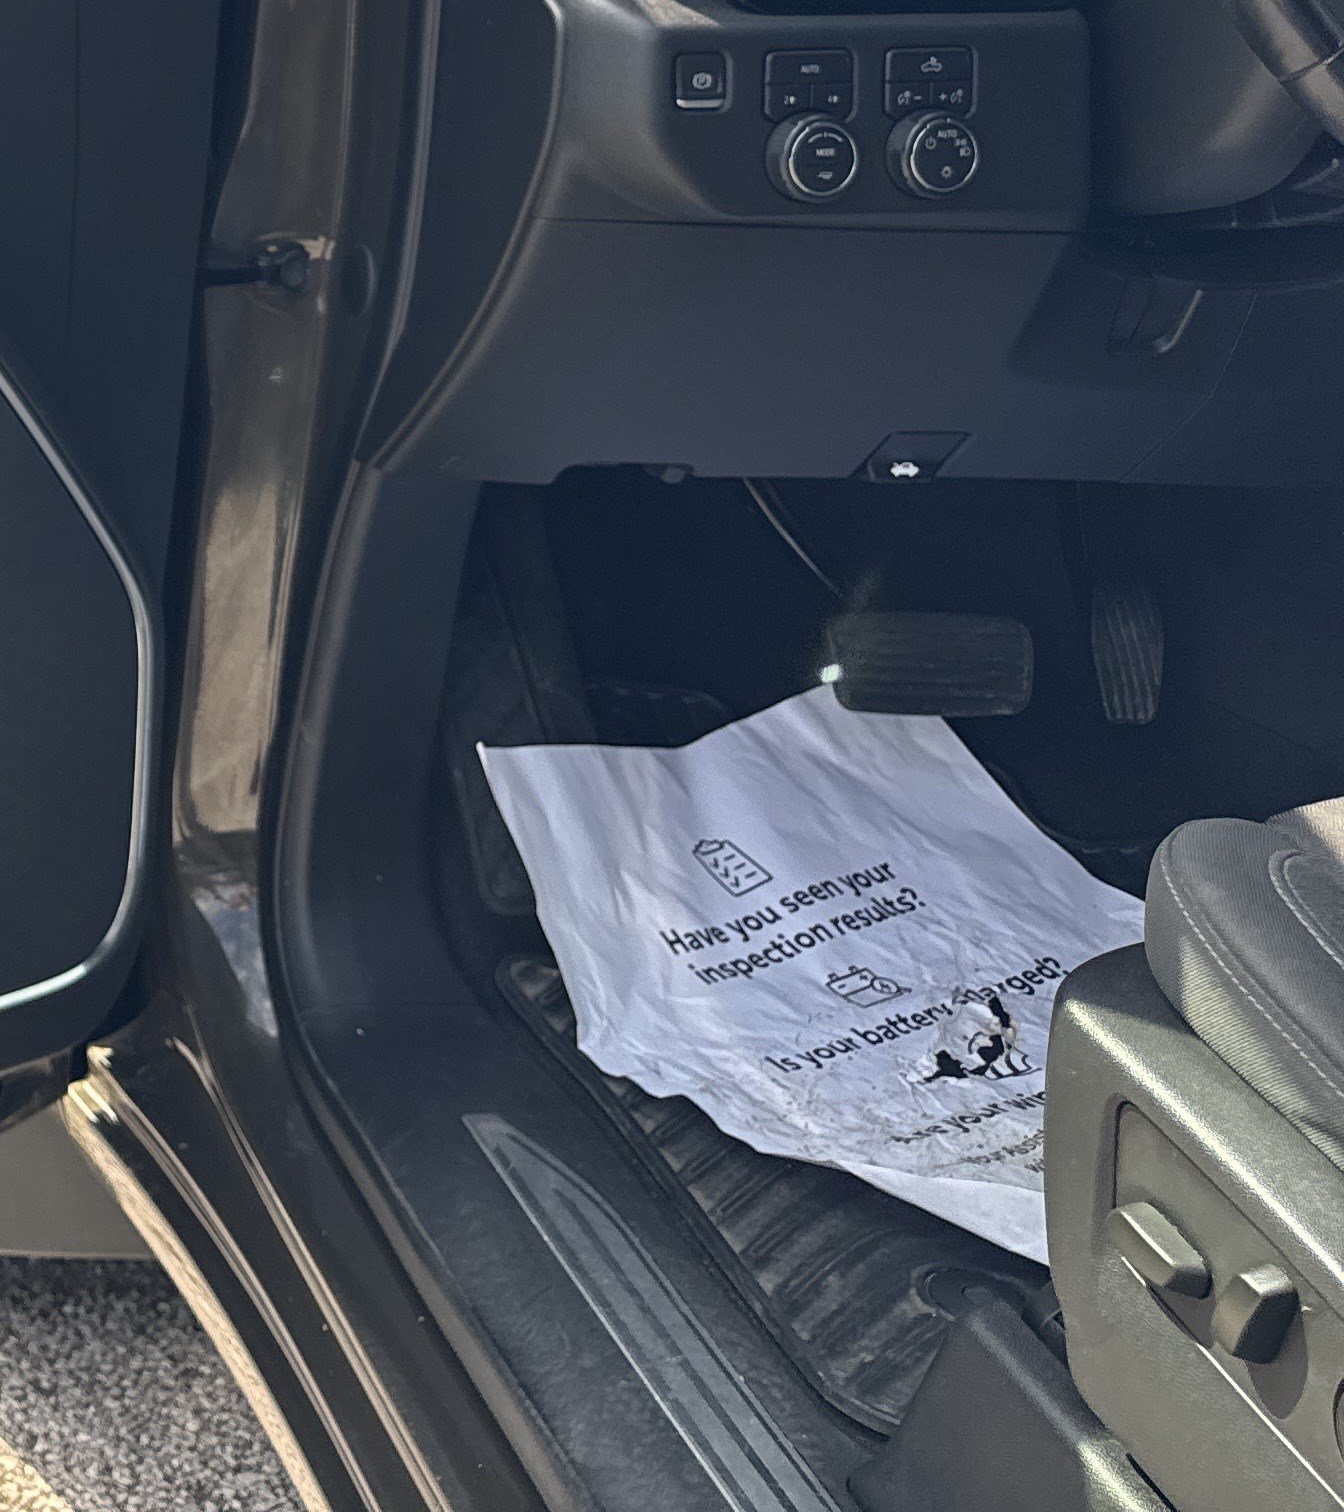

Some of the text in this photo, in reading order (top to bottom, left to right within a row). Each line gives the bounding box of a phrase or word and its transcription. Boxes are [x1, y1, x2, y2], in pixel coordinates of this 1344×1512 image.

[660, 862, 897, 955] Have you seen your
[687, 887, 926, 985] inspection results?
[766, 1051, 797, 1074] Is
[790, 1035, 861, 1071] your
[850, 1001, 954, 1047] battery
[941, 1102, 1009, 1134] your
